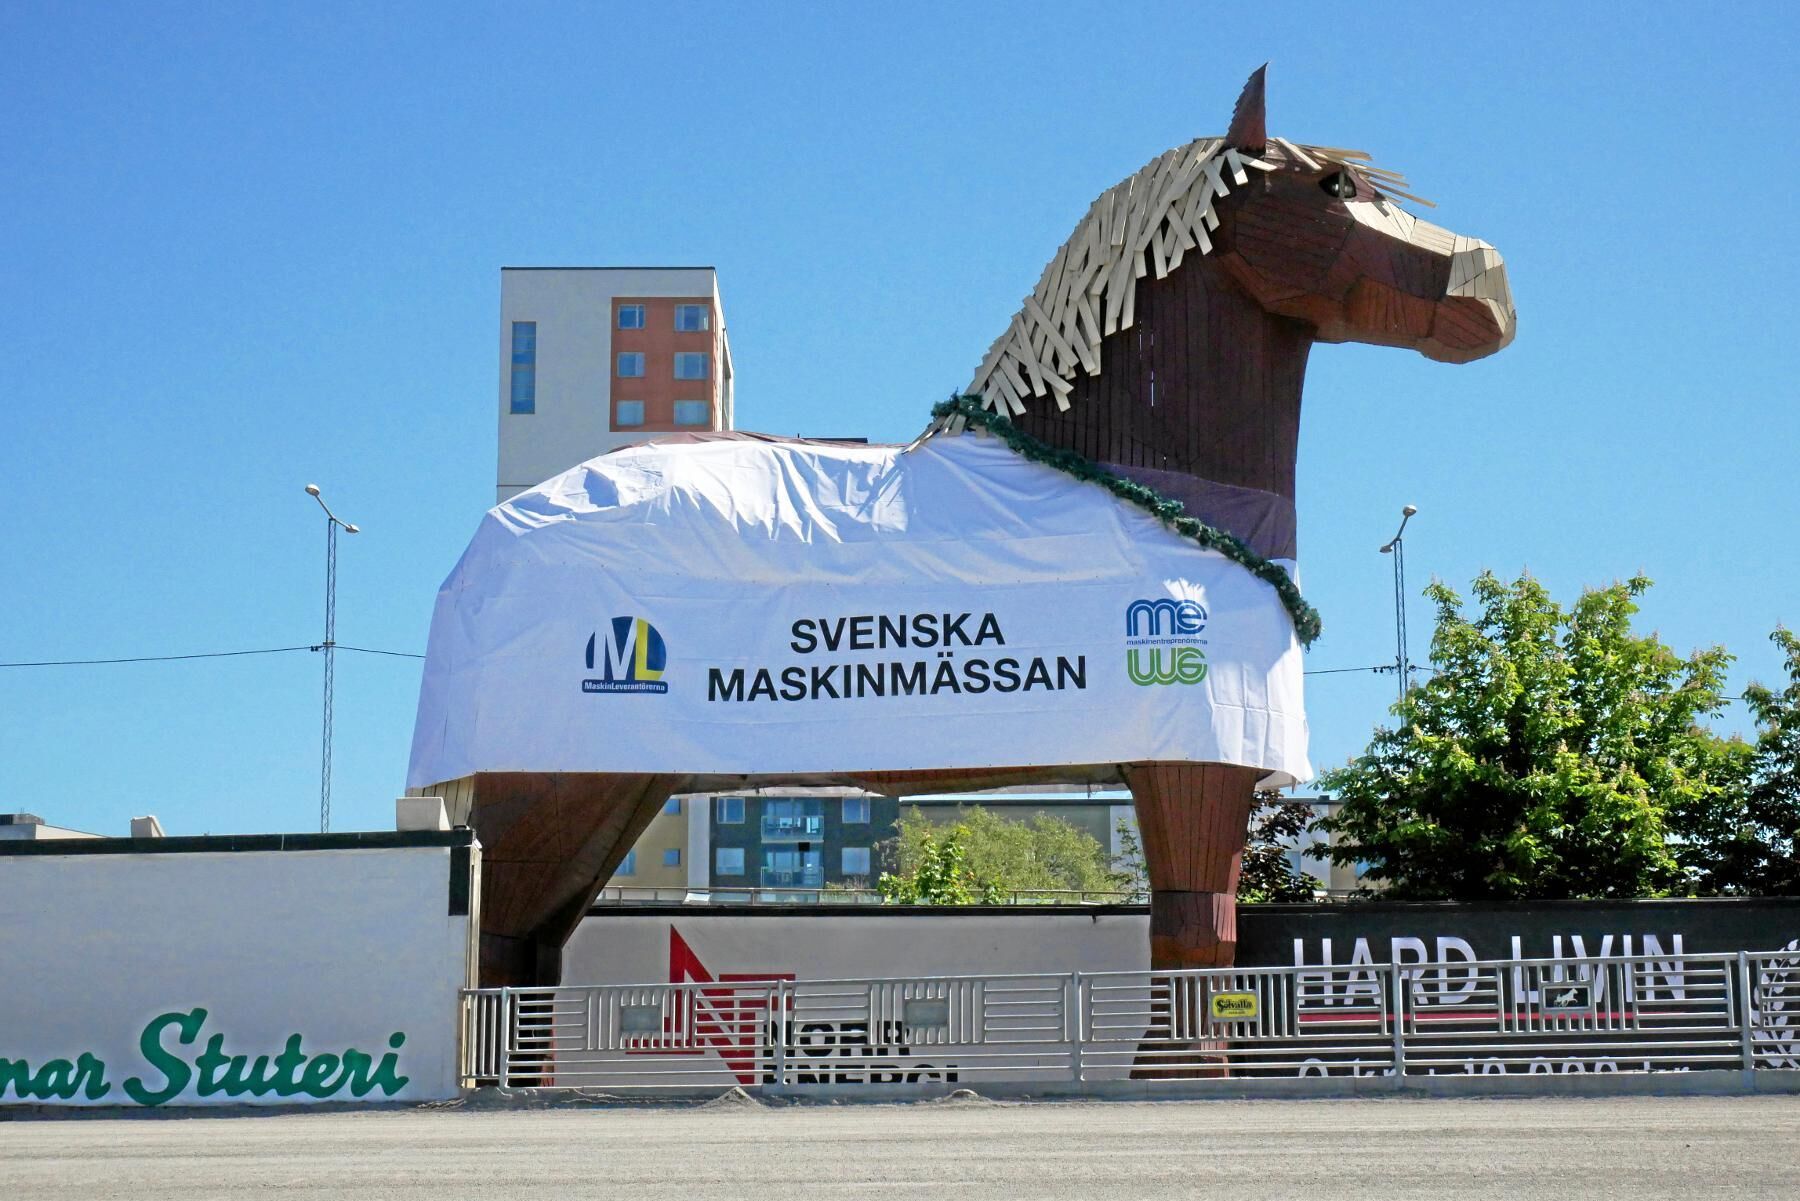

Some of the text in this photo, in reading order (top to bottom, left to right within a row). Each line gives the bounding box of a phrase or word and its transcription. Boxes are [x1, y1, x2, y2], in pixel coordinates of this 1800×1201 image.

[791, 610, 1005, 654] SVENSKA
[707, 651, 1086, 702] MASKINMÄSSAN
[1294, 936, 1478, 1005] HARD
[123, 1007, 408, 1105] Stuteri
